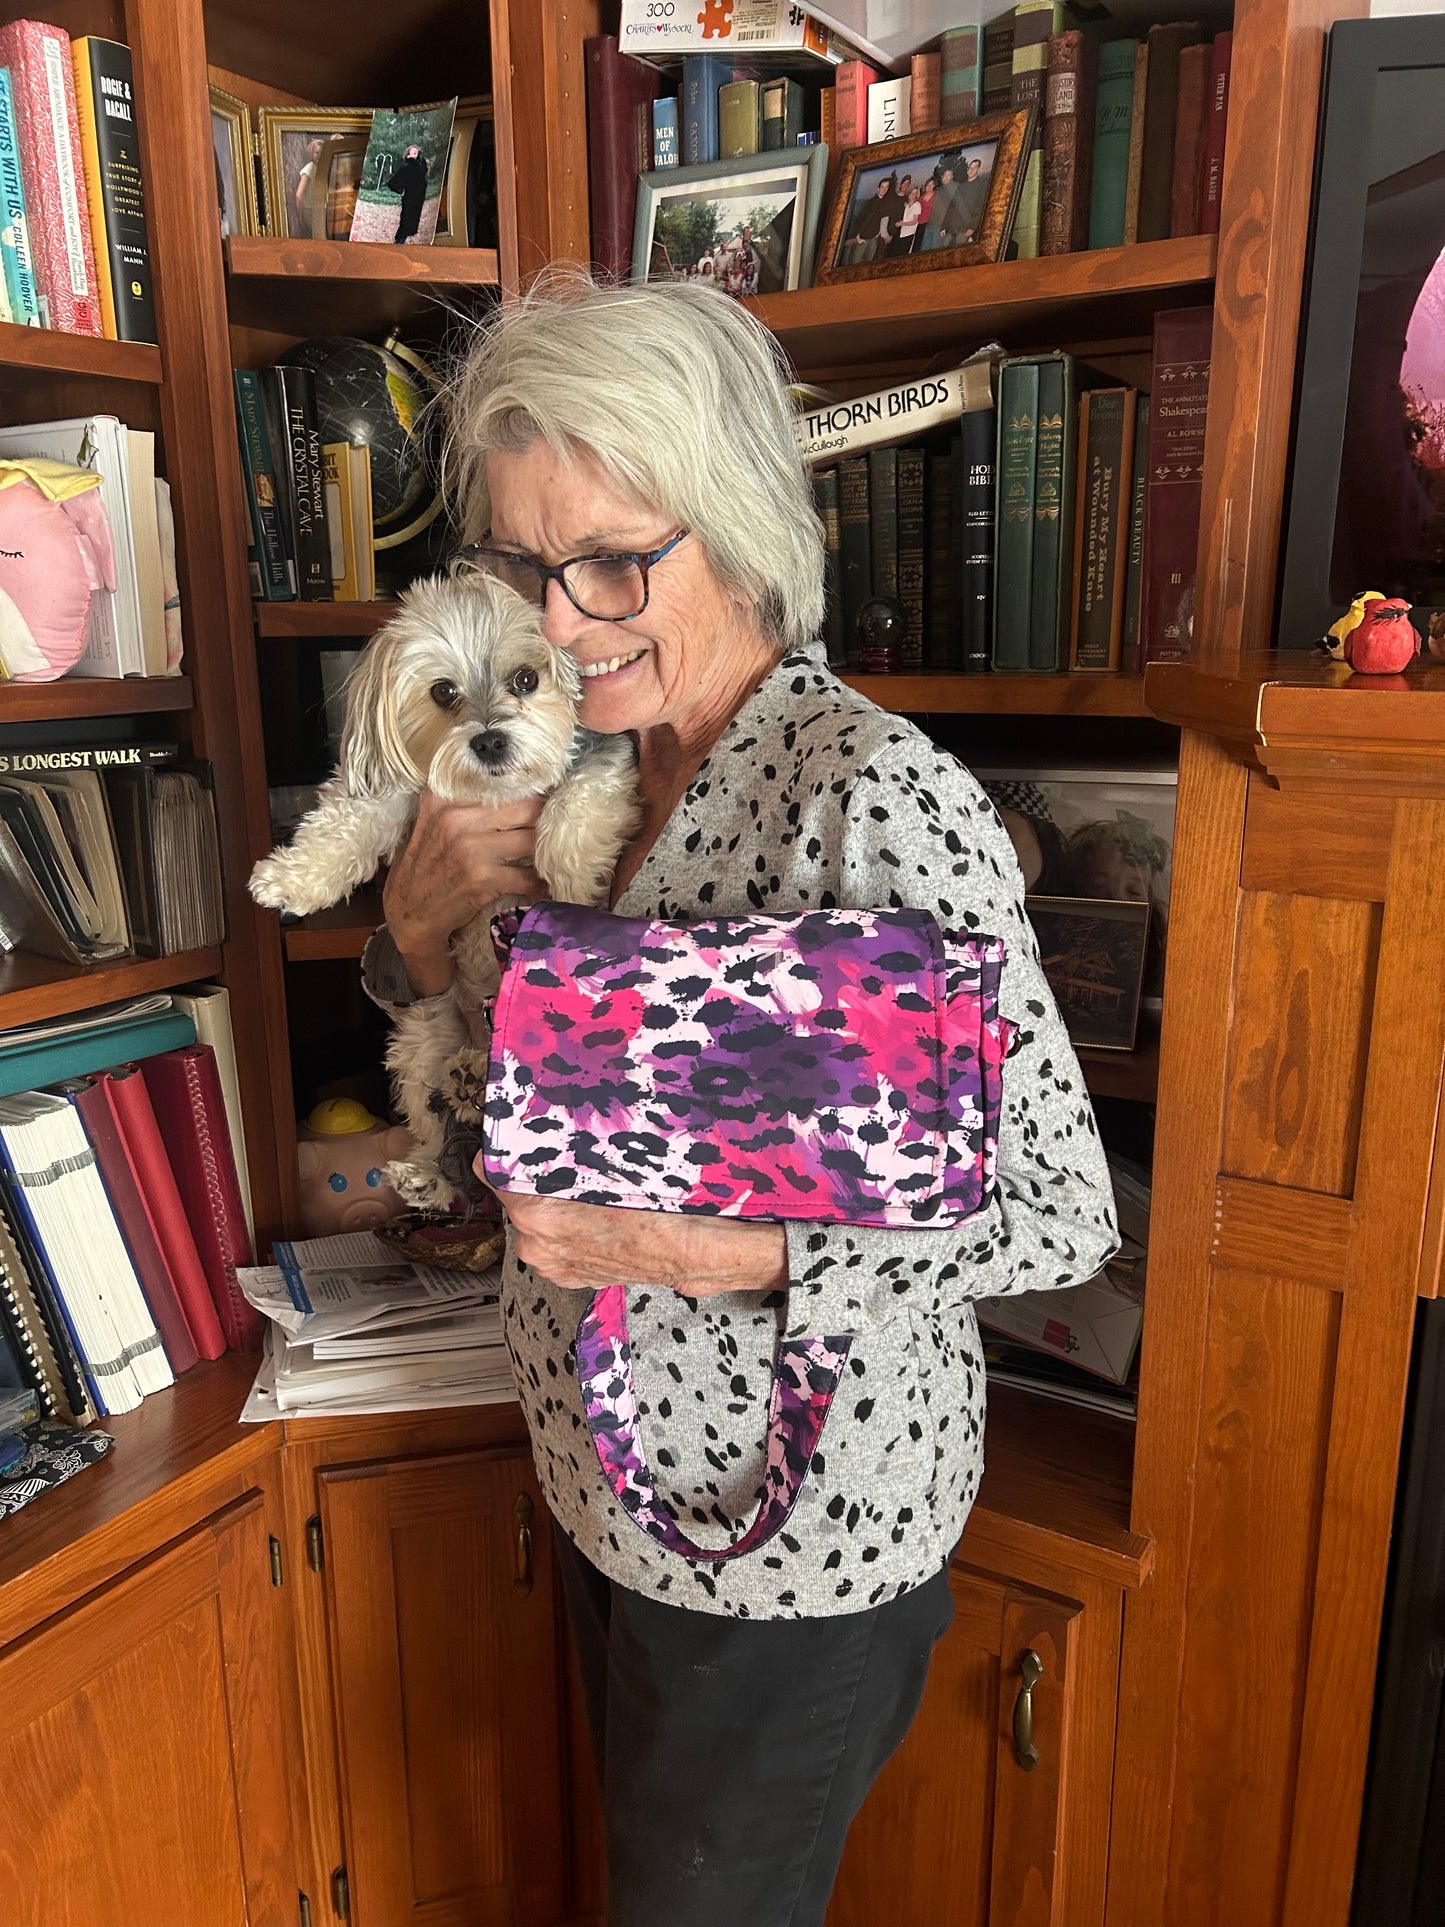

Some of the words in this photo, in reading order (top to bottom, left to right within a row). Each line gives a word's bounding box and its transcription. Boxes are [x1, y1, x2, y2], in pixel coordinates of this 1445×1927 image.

[646, 2, 675, 18] 300
[100, 76, 124, 98] BOGIE
[124, 82, 132, 100] &
[1016, 90, 1040, 101] LOST
[1020, 78, 1038, 90] THE
[1215, 72, 1225, 98] PETER
[104, 98, 132, 122] BACALL
[1215, 98, 1224, 112] PAN
[655, 127, 674, 139] MEN
[660, 140, 671, 152] OF
[690, 121, 698, 165] SAXON
[2, 157, 19, 195] WITH
[105, 172, 120, 180] TRUE
[121, 175, 137, 183] STORY
[107, 161, 139, 173] SURPRISING
[114, 196, 140, 206] GREATEST
[1208, 175, 1217, 202] BARRIE
[8, 197, 22, 219] US
[127, 210, 144, 218] AFFAIR
[13, 226, 26, 272] COLLEEN
[115, 243, 142, 254] WILLIAM
[123, 256, 144, 265] MANN
[19, 272, 33, 312] HOOVER
[244, 391, 257, 424] MARY
[291, 406, 306, 435] THE
[805, 396, 882, 439] THORN
[888, 379, 949, 418] BIRDS
[308, 429, 320, 468] Mary
[293, 437, 310, 497] CRYSTAL
[1093, 456, 1101, 476] at
[969, 475, 994, 486] BIBL
[1101, 467, 1112, 512] Bury
[311, 469, 324, 520] Stewart
[1135, 477, 1145, 514] BLACK
[297, 498, 313, 536] CAVE
[1088, 478, 1101, 561] Wounded
[1098, 516, 1109, 543] My
[267, 529, 278, 560] Hollow
[1132, 520, 1142, 565] BEAUTY
[271, 562, 284, 583] Hills
[1096, 547, 1107, 600] Heart
[1085, 565, 1096, 612] Knee
[13, 751, 92, 771] LONGEST
[94, 749, 141, 765] WALK
